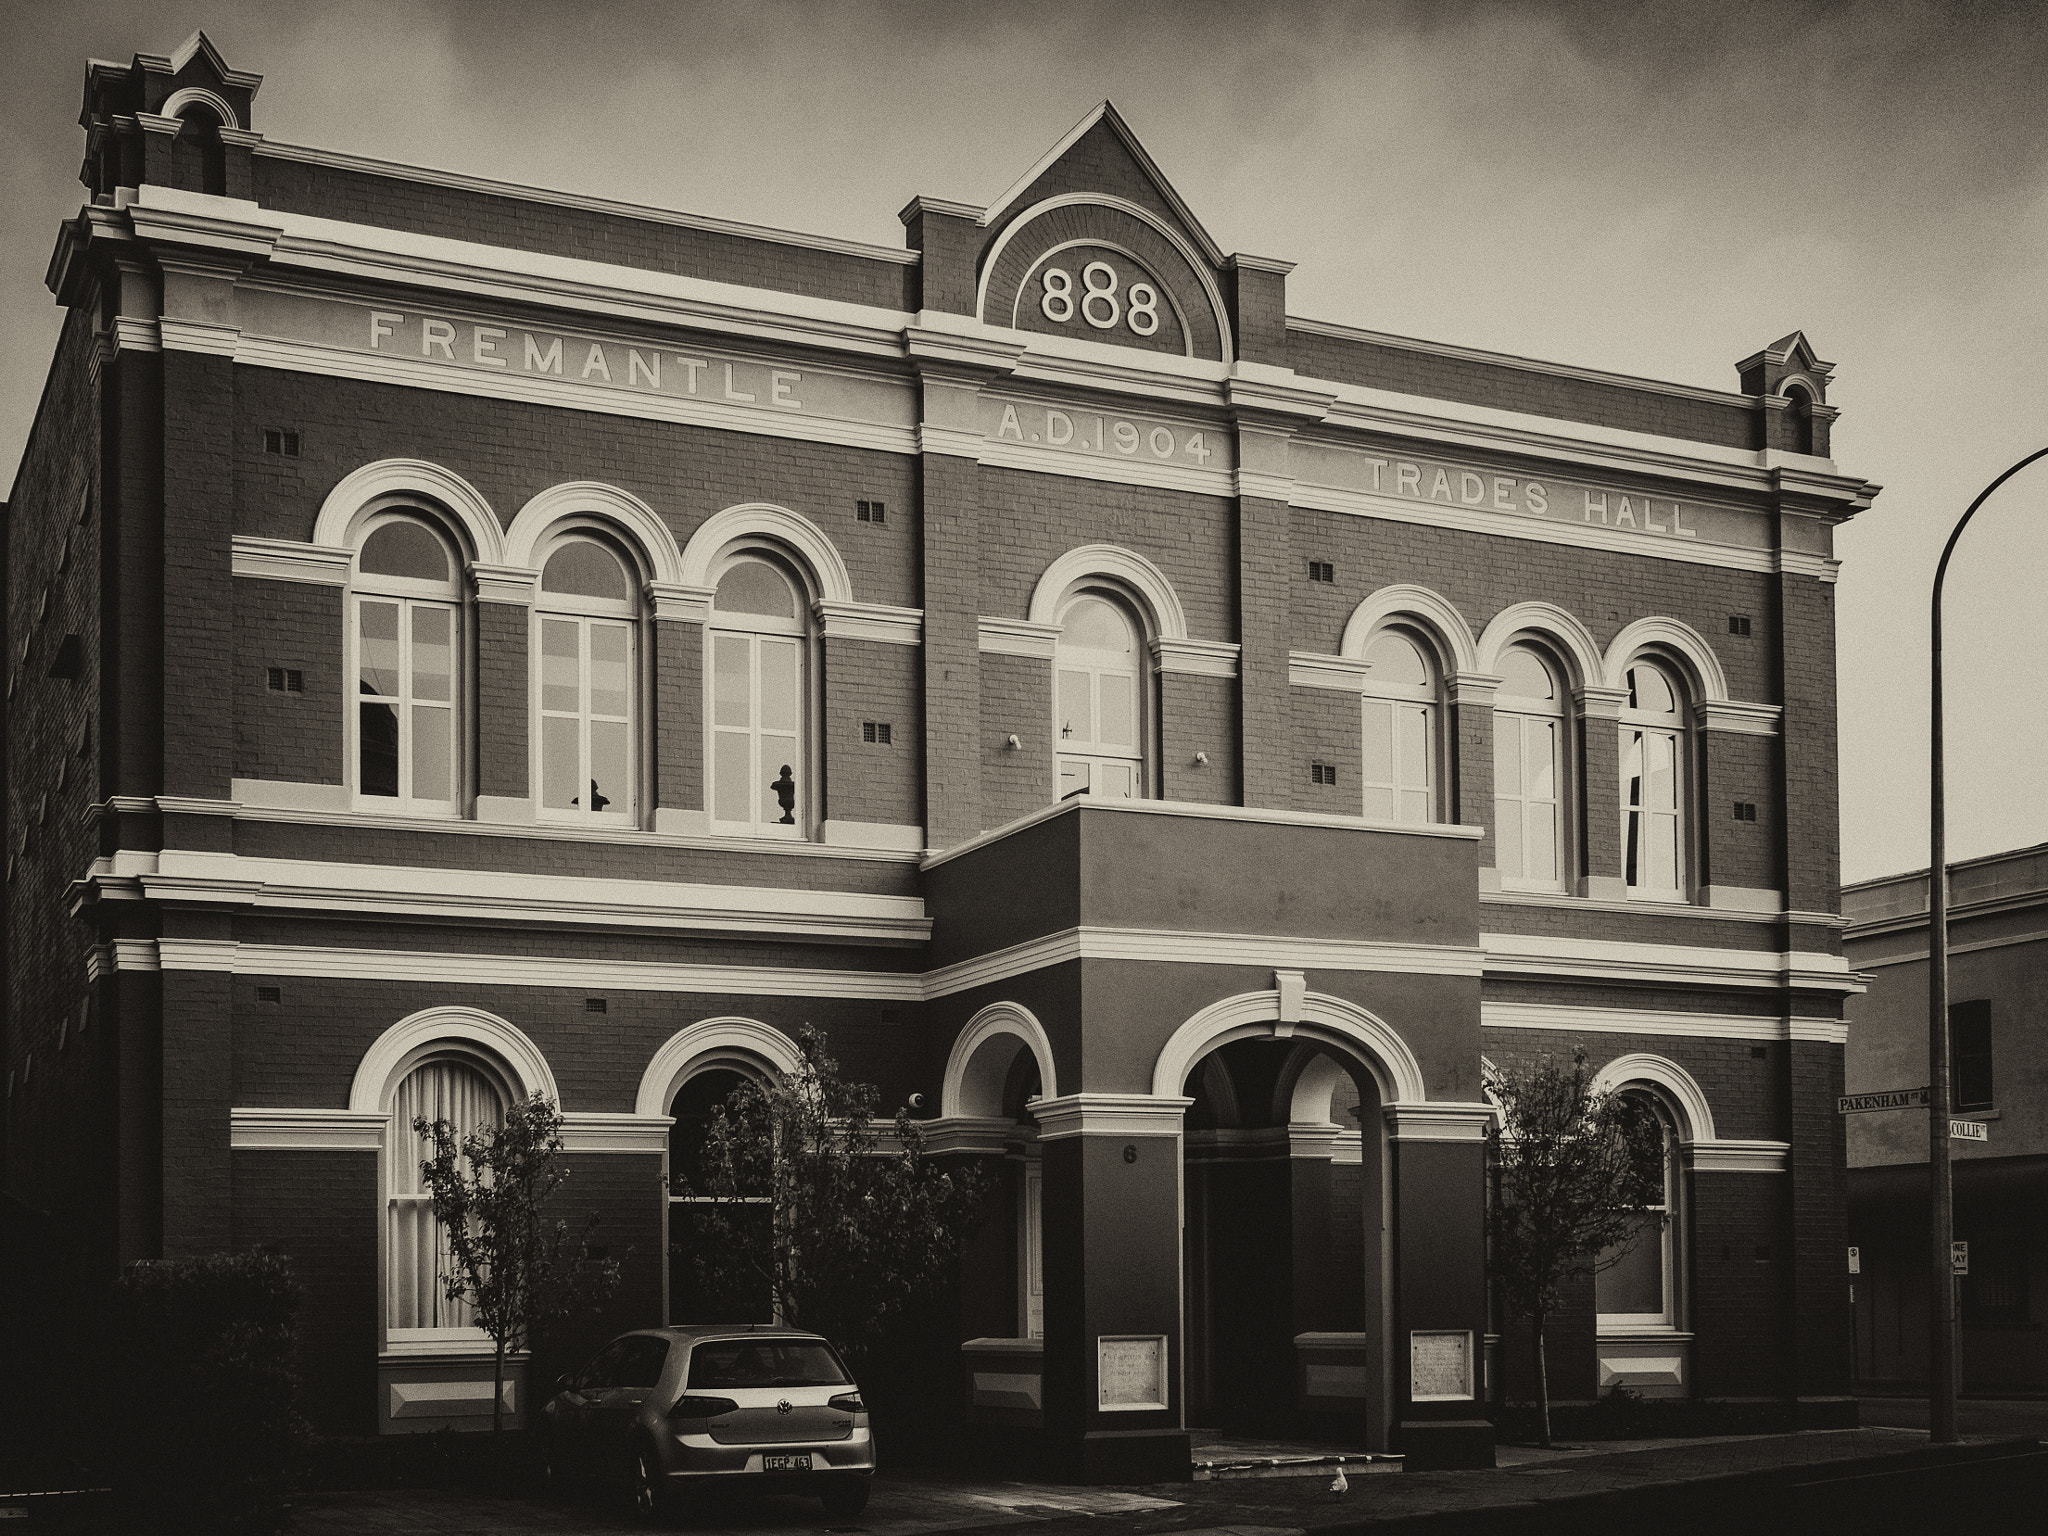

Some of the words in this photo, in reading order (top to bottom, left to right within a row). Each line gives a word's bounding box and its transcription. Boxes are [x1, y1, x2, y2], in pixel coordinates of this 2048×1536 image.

[369, 310, 803, 408] FREMANTLE
[1364, 457, 1550, 515] TRADES
[1584, 490, 1697, 537] HALL
[1839, 1093, 1910, 1111] PAKENHAM
[1951, 1121, 1981, 1138] COLLIE
[1123, 1144, 1138, 1164] 6
[1953, 1243, 1966, 1252] NE
[1953, 1254, 1966, 1263] AY
